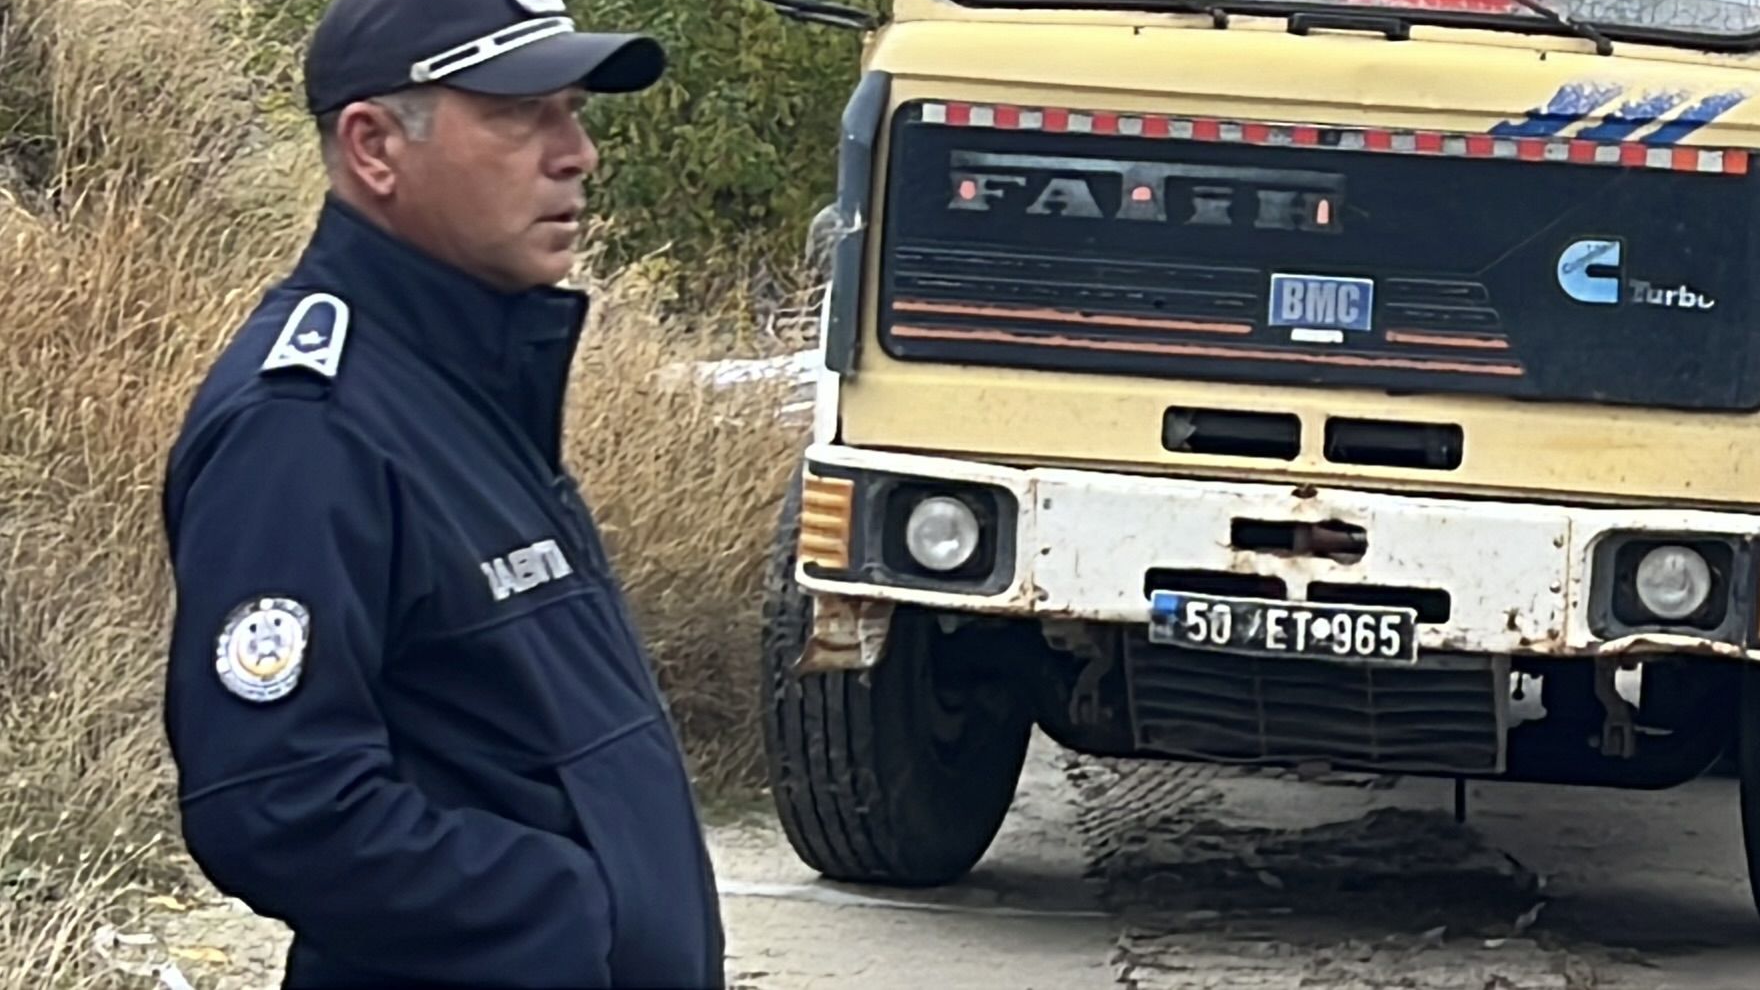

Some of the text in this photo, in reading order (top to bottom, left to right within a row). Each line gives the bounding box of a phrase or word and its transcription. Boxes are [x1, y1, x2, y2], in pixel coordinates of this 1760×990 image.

[1281, 280, 1360, 324] BMC
[1186, 601, 1231, 644] 50
[1331, 613, 1400, 655] 965
